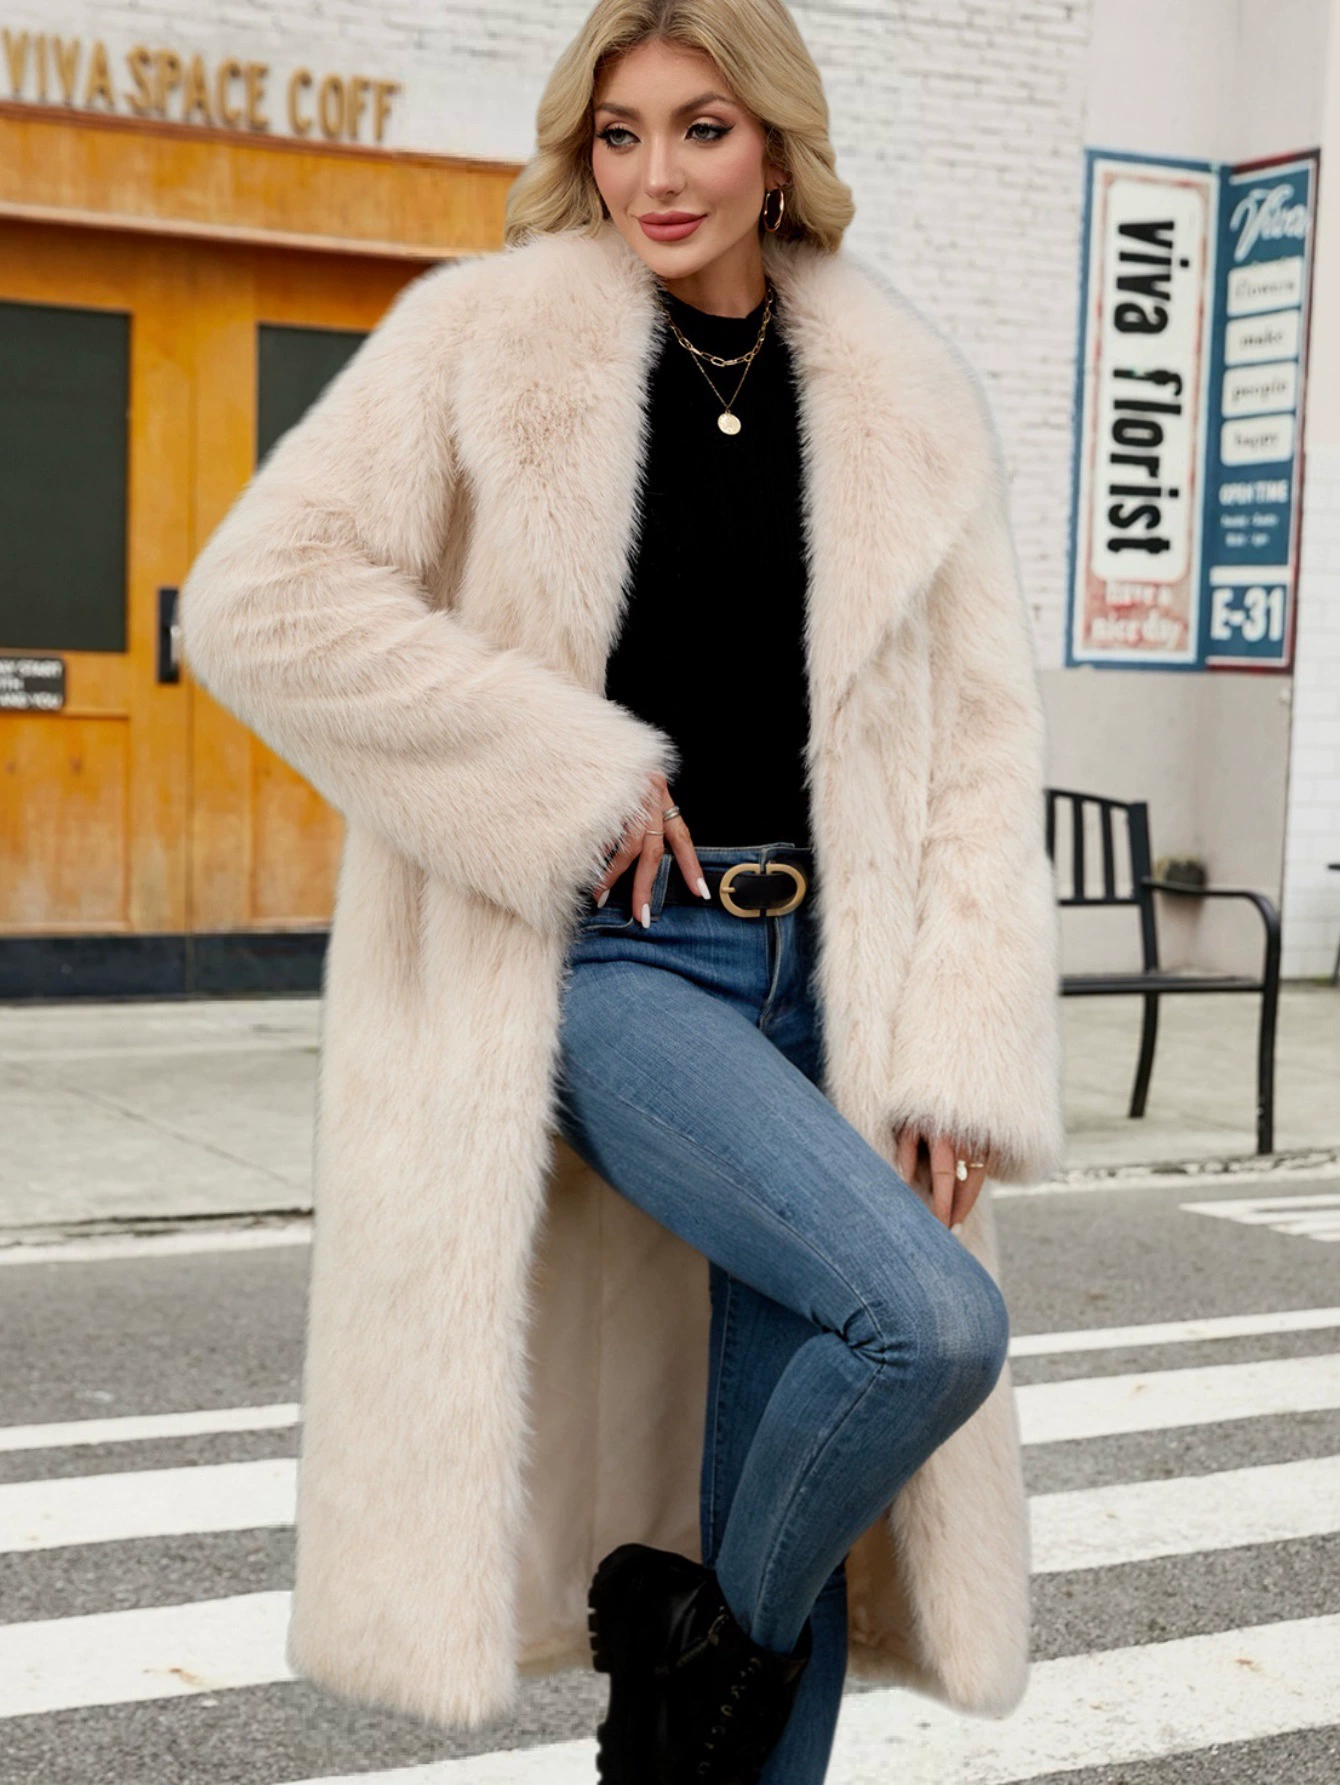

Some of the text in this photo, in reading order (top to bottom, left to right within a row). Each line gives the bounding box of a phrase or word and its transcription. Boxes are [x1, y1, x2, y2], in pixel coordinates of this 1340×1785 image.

[125, 45, 270, 134] SPACE
[287, 67, 400, 142] COFF
[1107, 221, 1190, 555] viva florist
[1210, 586, 1286, 642] E-31
